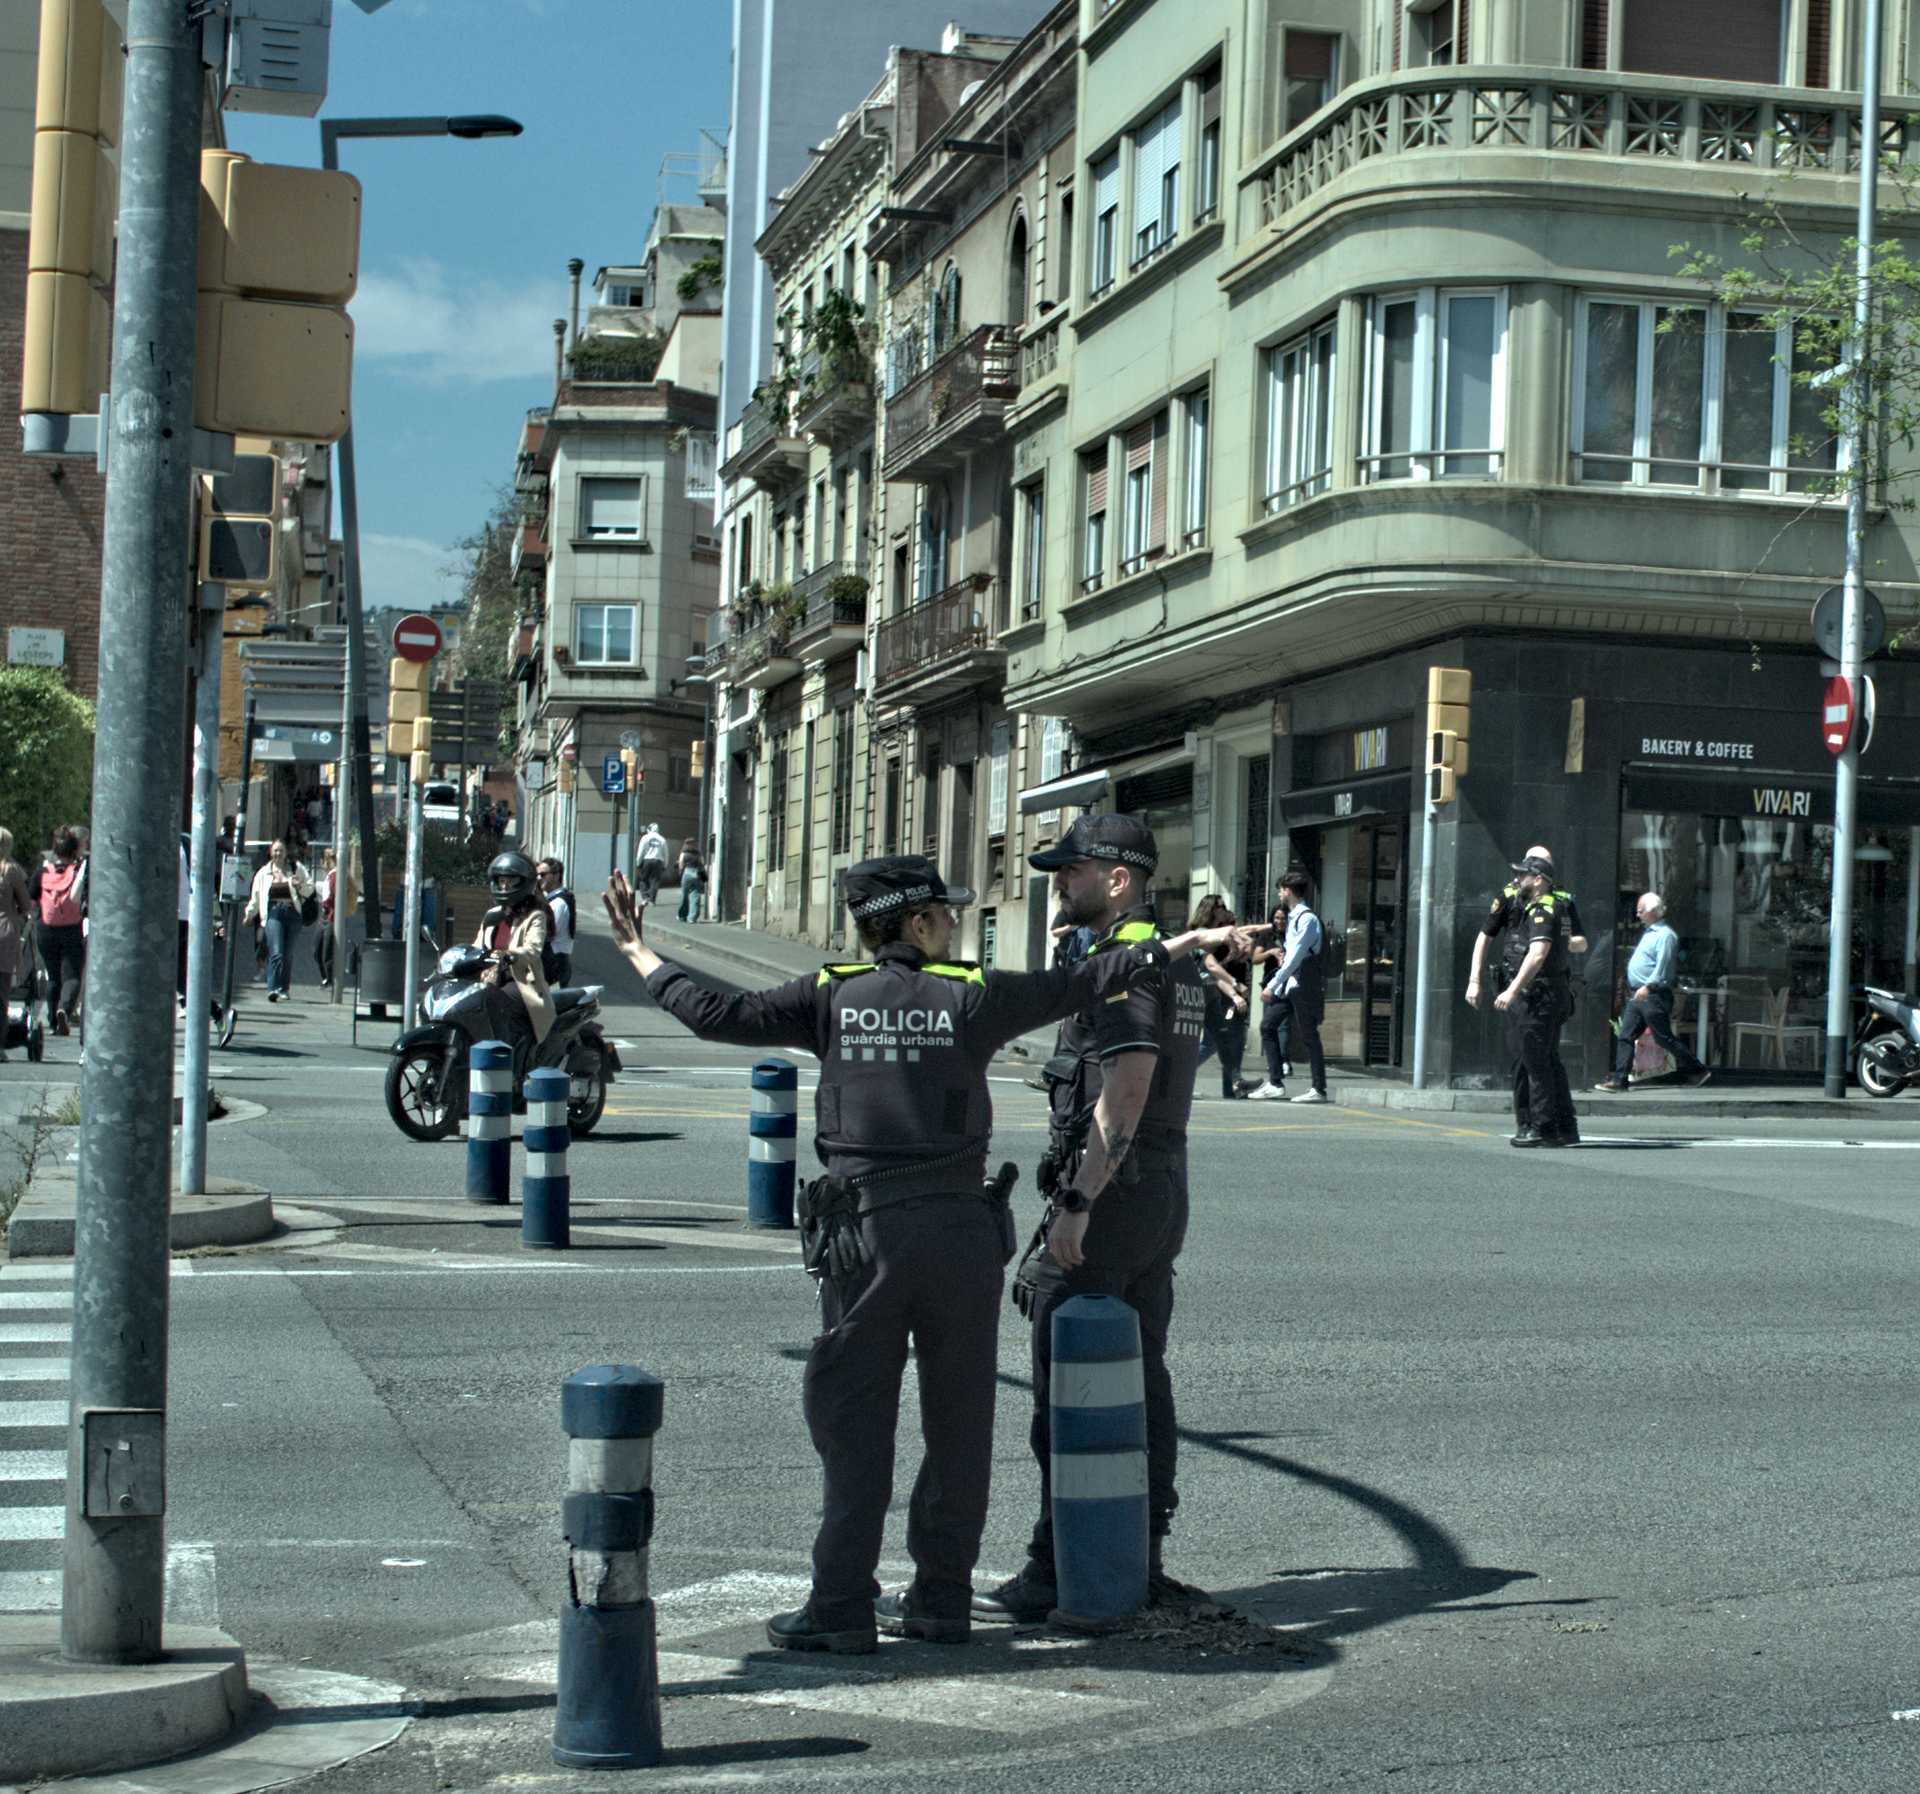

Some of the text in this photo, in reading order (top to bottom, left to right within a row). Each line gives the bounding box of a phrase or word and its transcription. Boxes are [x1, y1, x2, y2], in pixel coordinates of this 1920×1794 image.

[1354, 727, 1387, 771] VIVARI
[1642, 738, 1754, 759] BAKERY & COFFEE
[607, 760, 620, 780] P
[1753, 789, 1811, 816] VIVARI
[840, 1007, 954, 1033] POLICIA
[840, 1032, 954, 1047] guàrdia urbana
